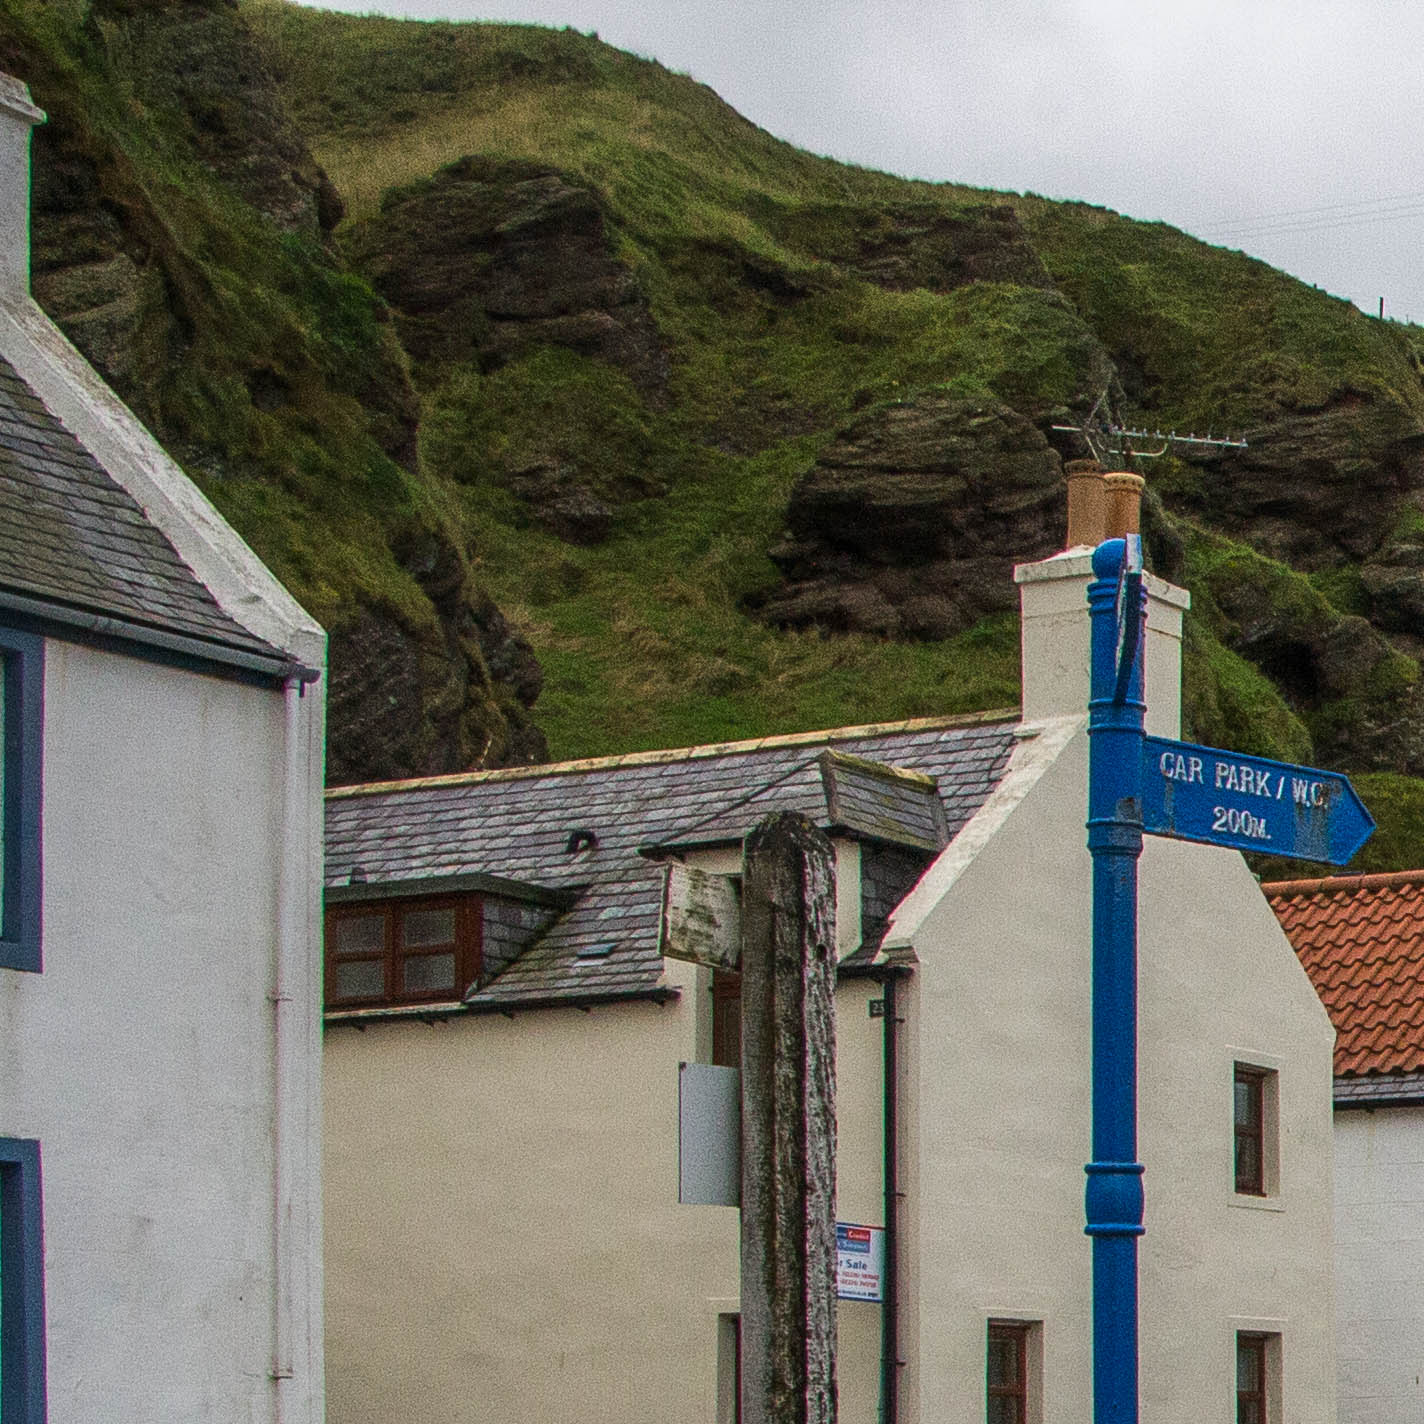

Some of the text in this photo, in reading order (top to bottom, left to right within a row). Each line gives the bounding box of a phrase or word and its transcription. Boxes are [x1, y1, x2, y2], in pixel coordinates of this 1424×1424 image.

[1160, 752, 1203, 785] CAR
[1215, 761, 1272, 797] PARK
[846, 1259, 868, 1271] Sale
